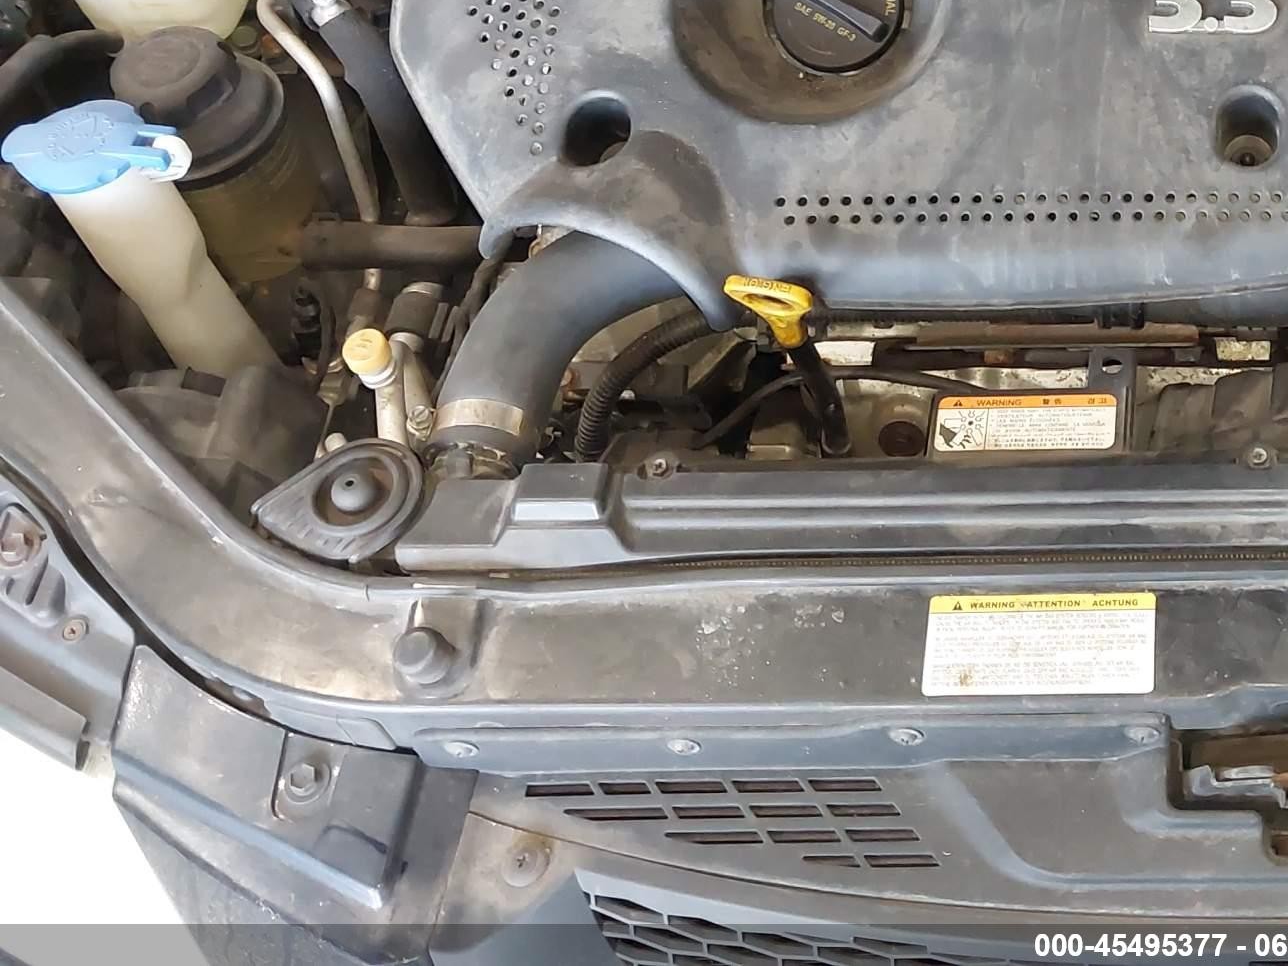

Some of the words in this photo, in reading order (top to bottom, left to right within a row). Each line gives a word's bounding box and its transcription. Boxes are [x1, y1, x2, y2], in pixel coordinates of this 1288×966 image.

[794, 2, 813, 17] SAE
[837, 26, 856, 42] GF-3
[976, 398, 1023, 407] WARNING
[970, 600, 1015, 610] WARNING
[1026, 599, 1081, 609] ATTENTION
[1092, 598, 1139, 608] ACHTUNG
